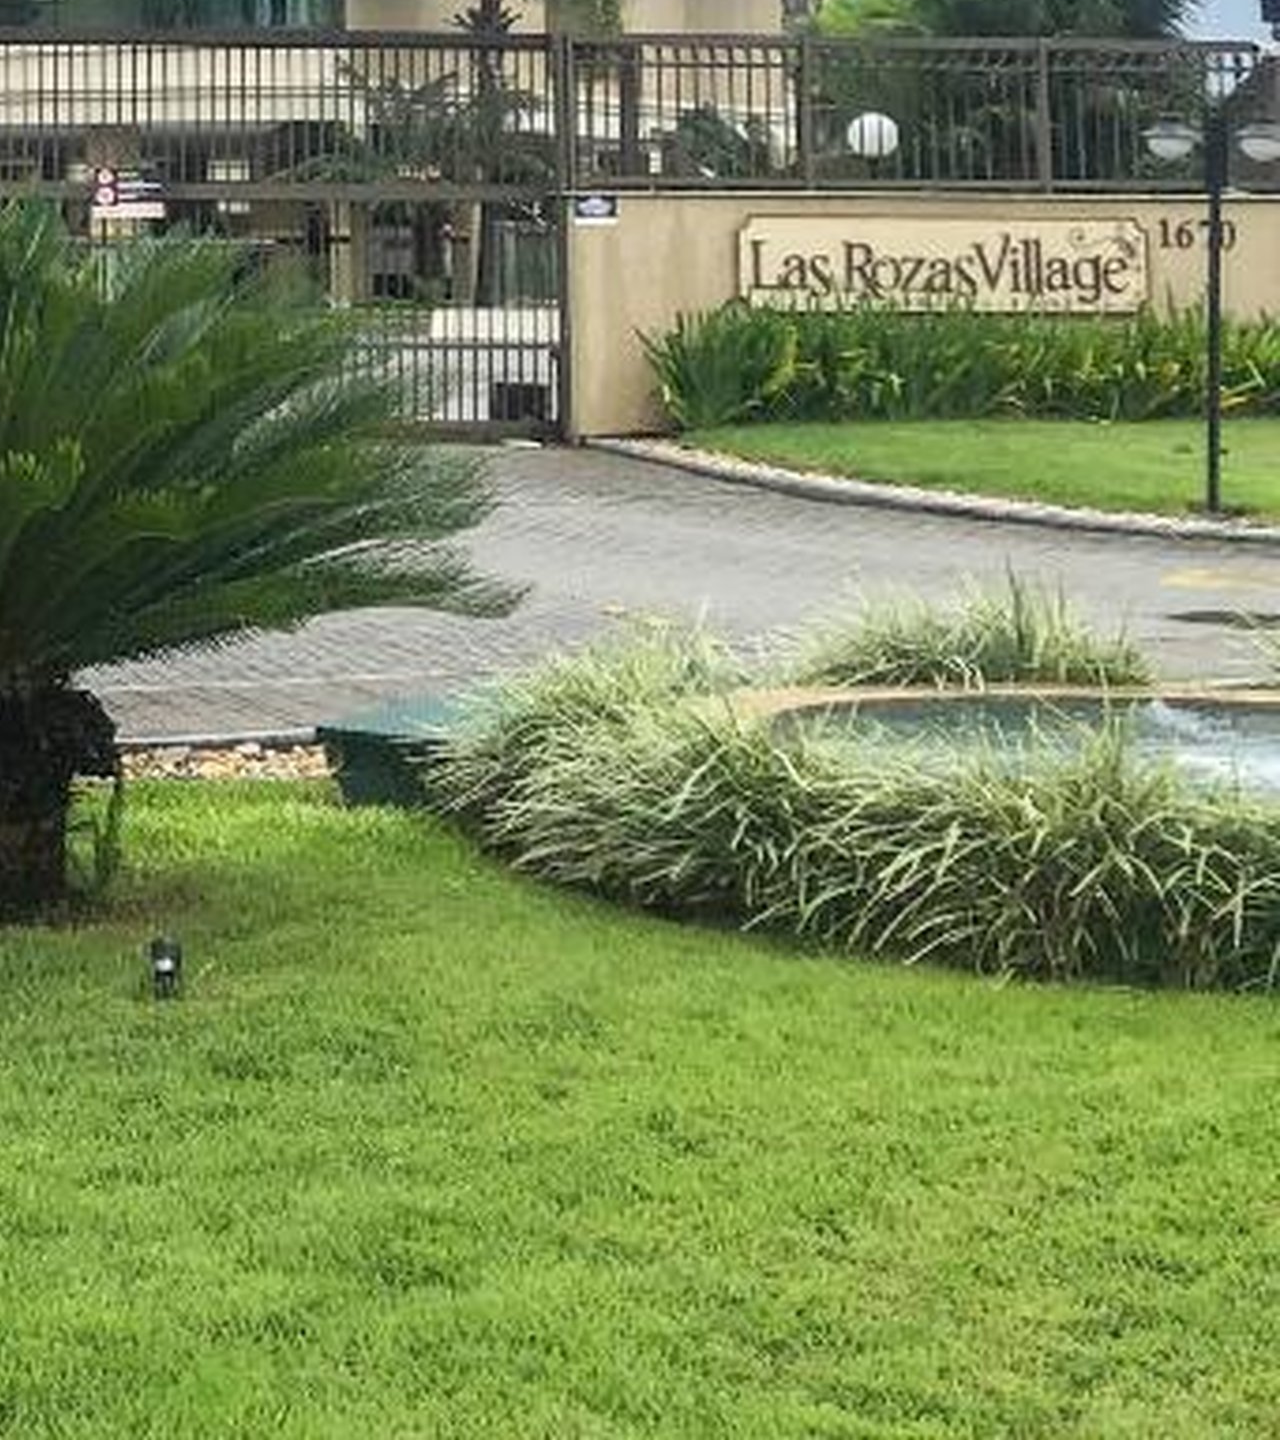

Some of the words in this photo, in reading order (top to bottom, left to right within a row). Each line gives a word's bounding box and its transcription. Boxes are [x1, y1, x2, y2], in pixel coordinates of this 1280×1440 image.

[750, 239, 831, 297] Las
[842, 239, 977, 300] Rozas
[971, 232, 1130, 304] Village
